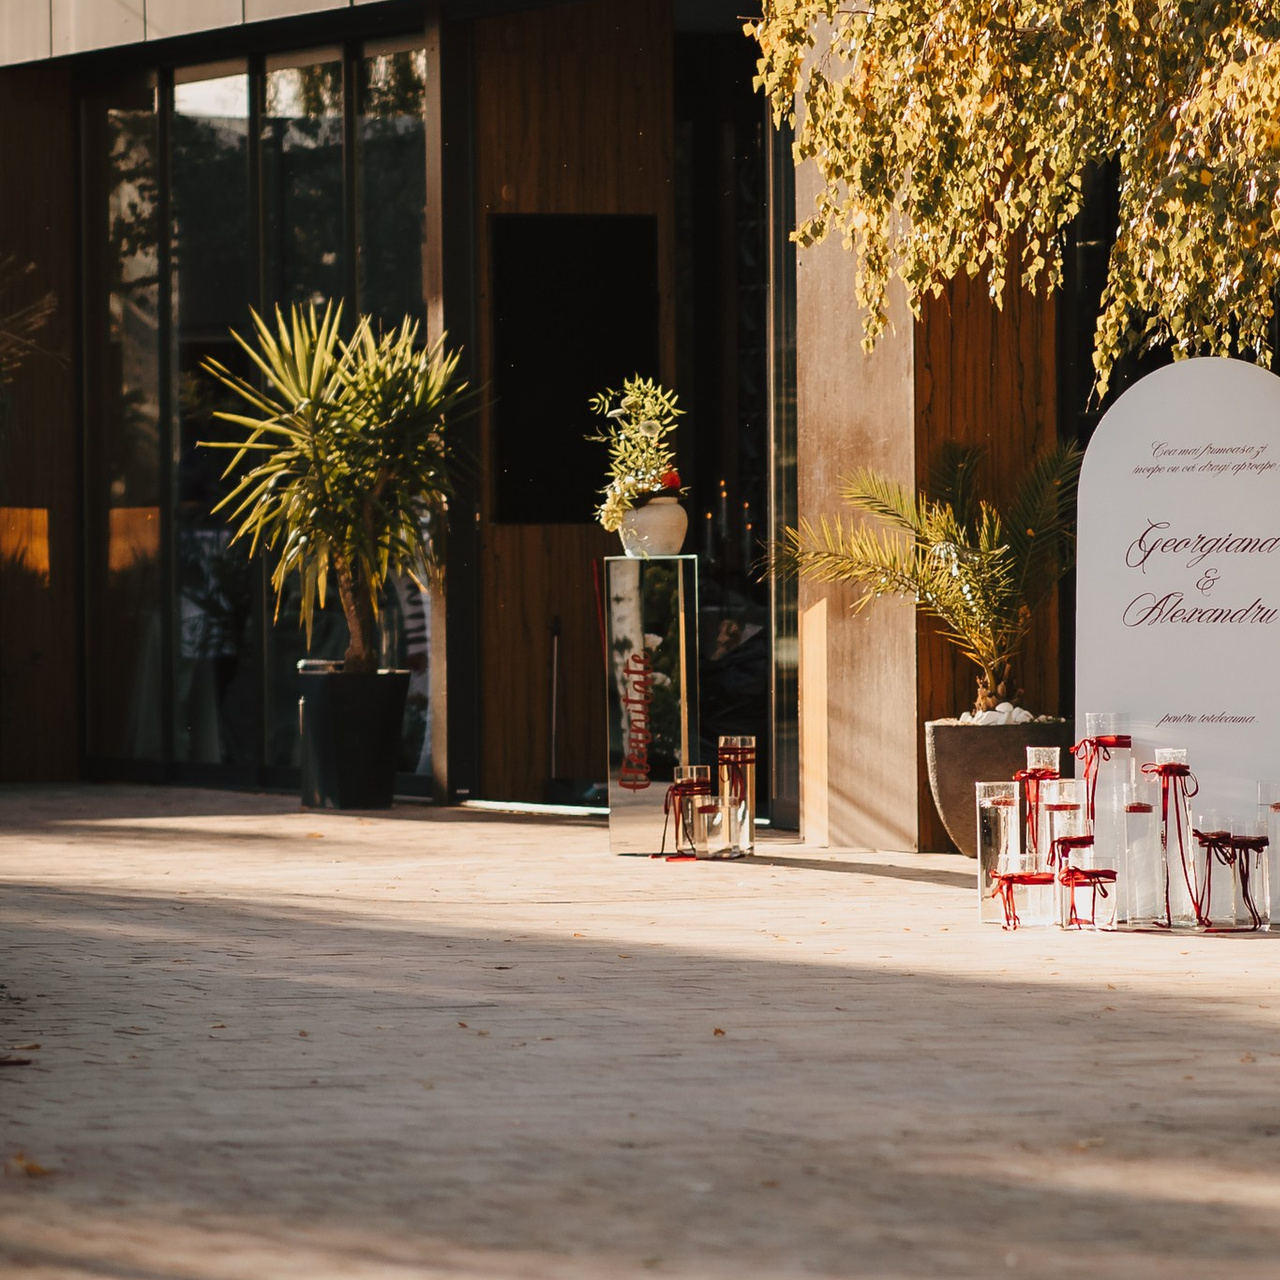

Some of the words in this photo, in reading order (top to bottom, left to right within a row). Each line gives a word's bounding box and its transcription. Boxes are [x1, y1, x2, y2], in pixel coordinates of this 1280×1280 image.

[1177, 445, 1203, 456] mai
[1197, 460, 1233, 478] dragi
[1195, 567, 1221, 597] &
[1122, 591, 1279, 627] Alexandru
[1155, 712, 1197, 728] pentru
